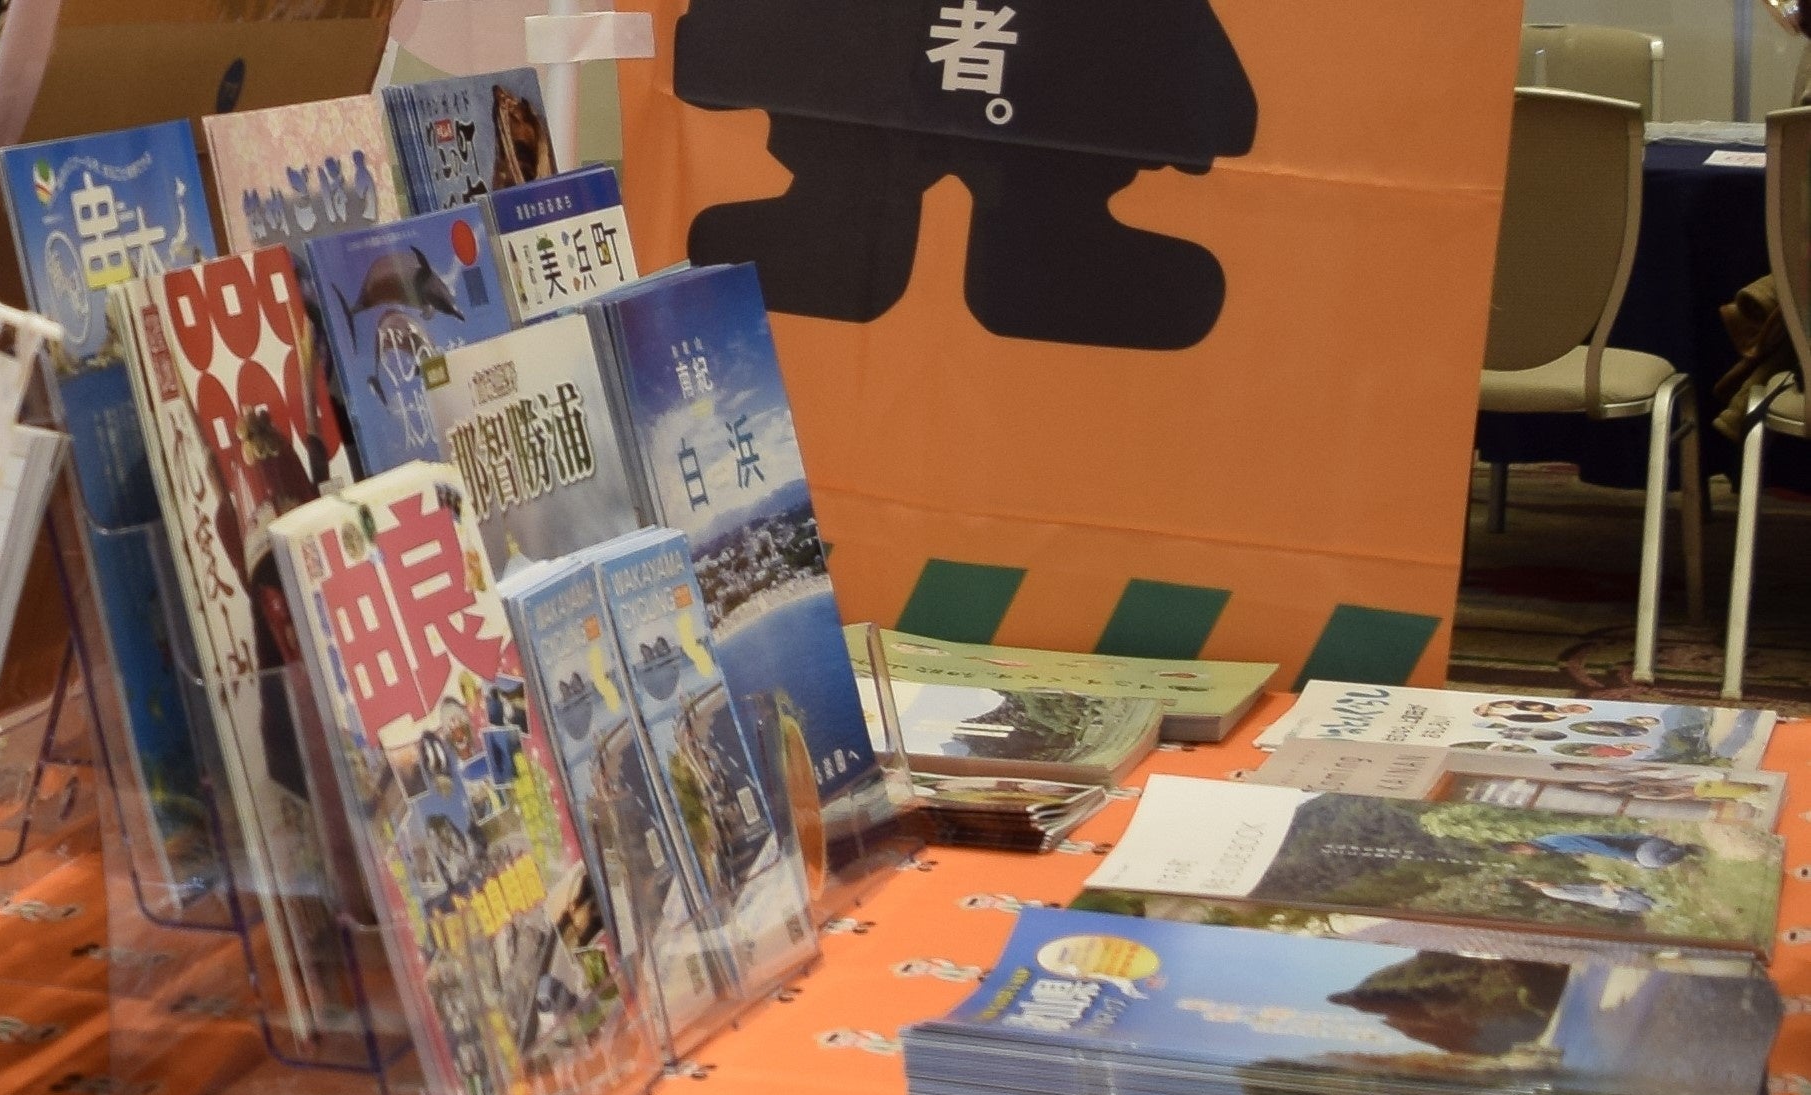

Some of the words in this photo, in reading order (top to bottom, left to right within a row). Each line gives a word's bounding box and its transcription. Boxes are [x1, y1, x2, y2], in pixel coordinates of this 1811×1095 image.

[927, 0, 1019, 126] 者。
[536, 221, 625, 299] 美浜町
[677, 413, 766, 512] 白浜
